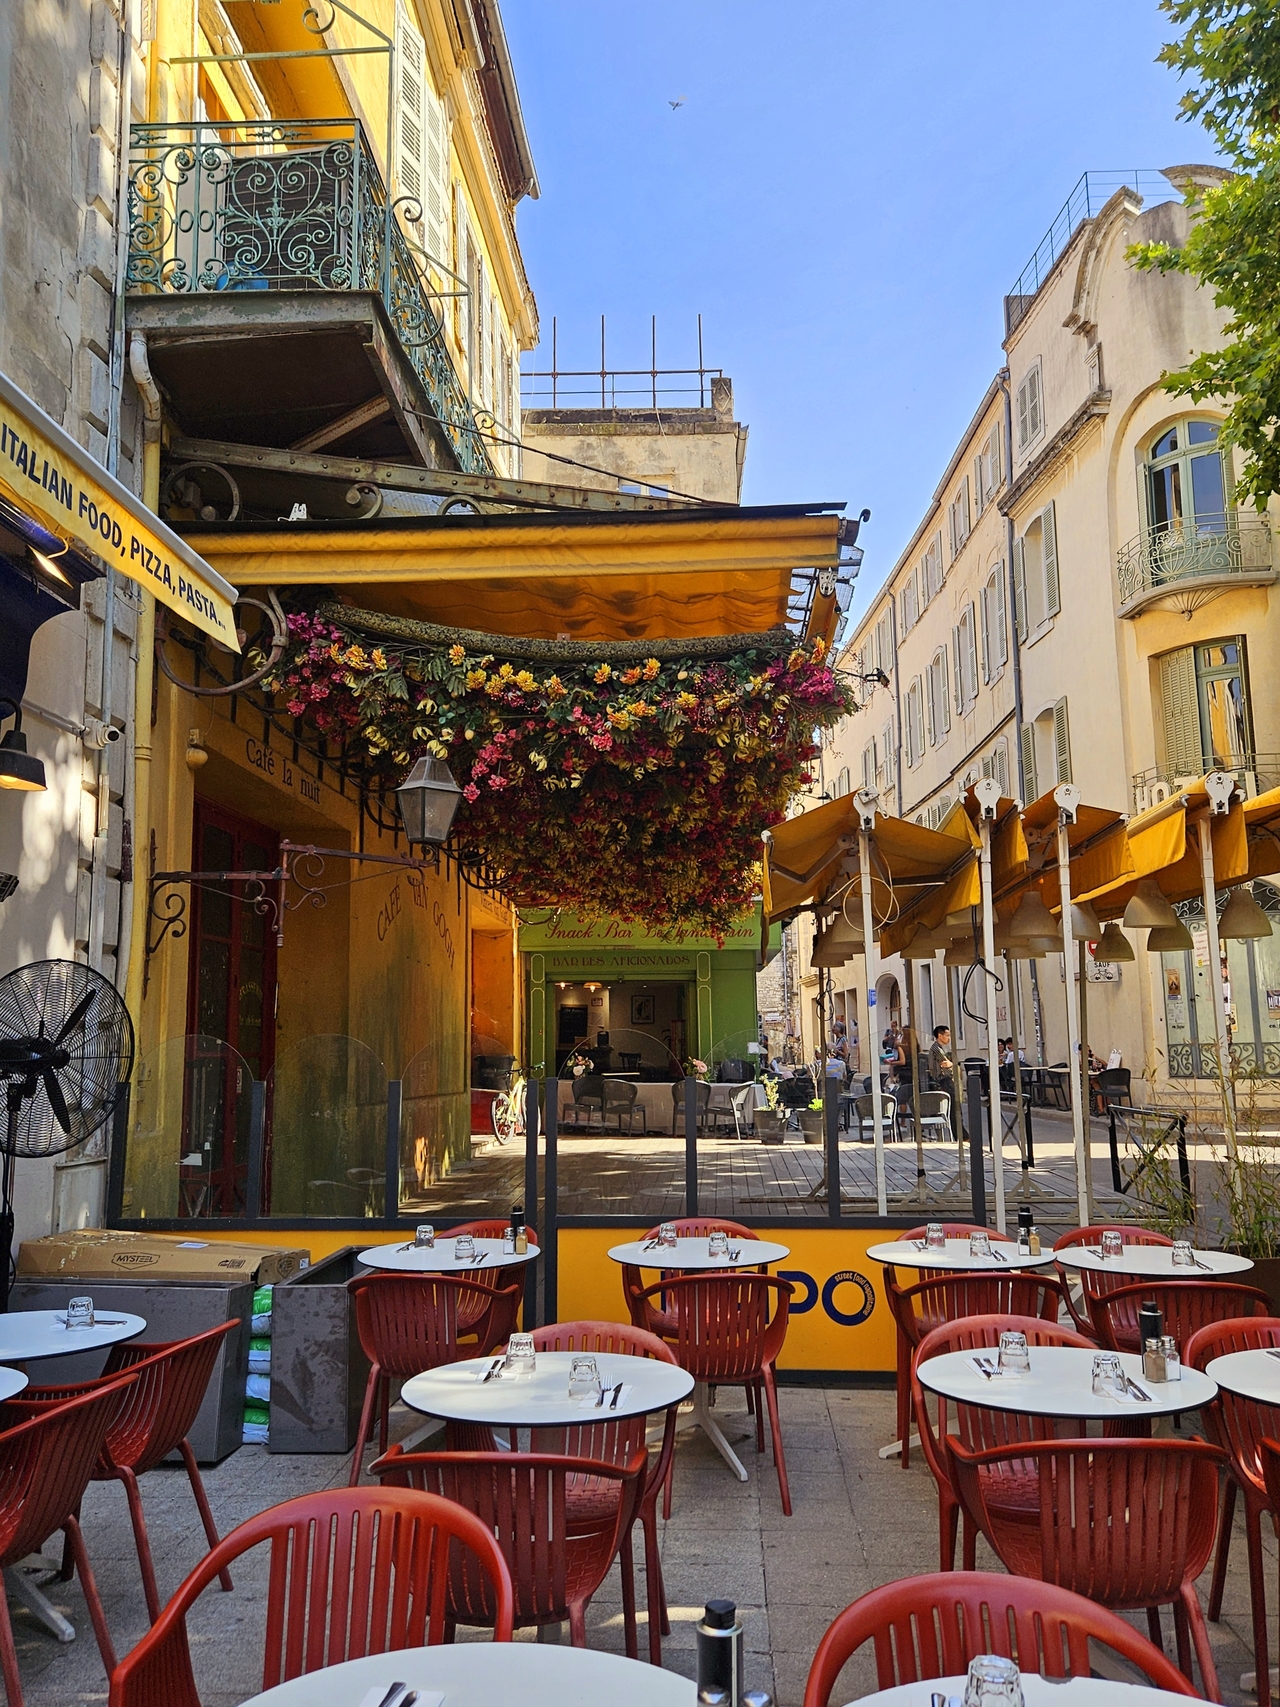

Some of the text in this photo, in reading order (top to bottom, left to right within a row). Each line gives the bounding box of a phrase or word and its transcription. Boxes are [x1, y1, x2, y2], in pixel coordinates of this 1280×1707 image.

[1, 422, 72, 511] ITALIAN
[79, 491, 126, 557] FOOD,
[131, 535, 176, 596] PIZZA,
[246, 738, 321, 804] Café la nuit
[377, 877, 402, 941] CAFÉ
[433, 901, 455, 971] GOGH
[545, 921, 596, 939] Snack
[598, 920, 634, 939] Bar
[553, 955, 690, 967] BAR DES AFICIONADOS
[116, 1254, 154, 1263] MYSTEEL
[834, 1272, 853, 1282] street
[853, 1272, 867, 1286] food
